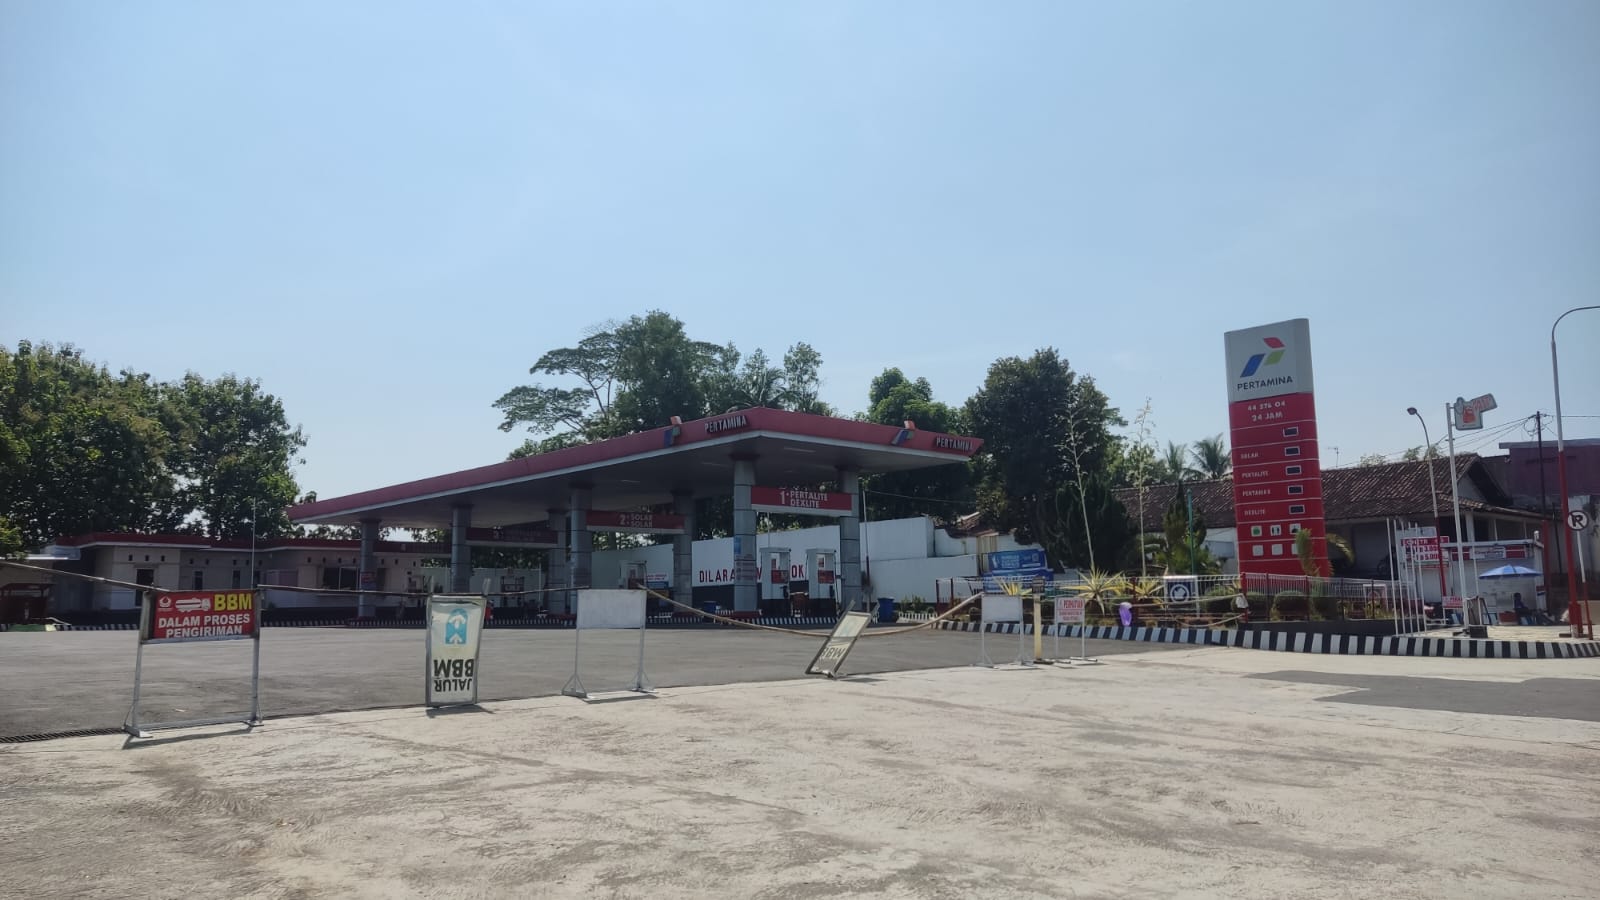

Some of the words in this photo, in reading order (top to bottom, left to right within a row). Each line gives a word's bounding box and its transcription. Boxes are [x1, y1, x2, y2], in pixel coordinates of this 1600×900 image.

[1237, 376, 1293, 390] PERTAMINA
[704, 415, 747, 433] PERTAMINA
[790, 490, 828, 501] PERTALITE
[790, 499, 820, 508] DEXLITE
[699, 569, 735, 583] DILARA
[214, 594, 252, 611] BBM
[159, 616, 200, 628] DALAM
[204, 614, 250, 625] PROSES
[166, 625, 242, 638] PENGIRIMAN
[433, 659, 474, 678] BBM
[434, 679, 472, 692] JALUR
